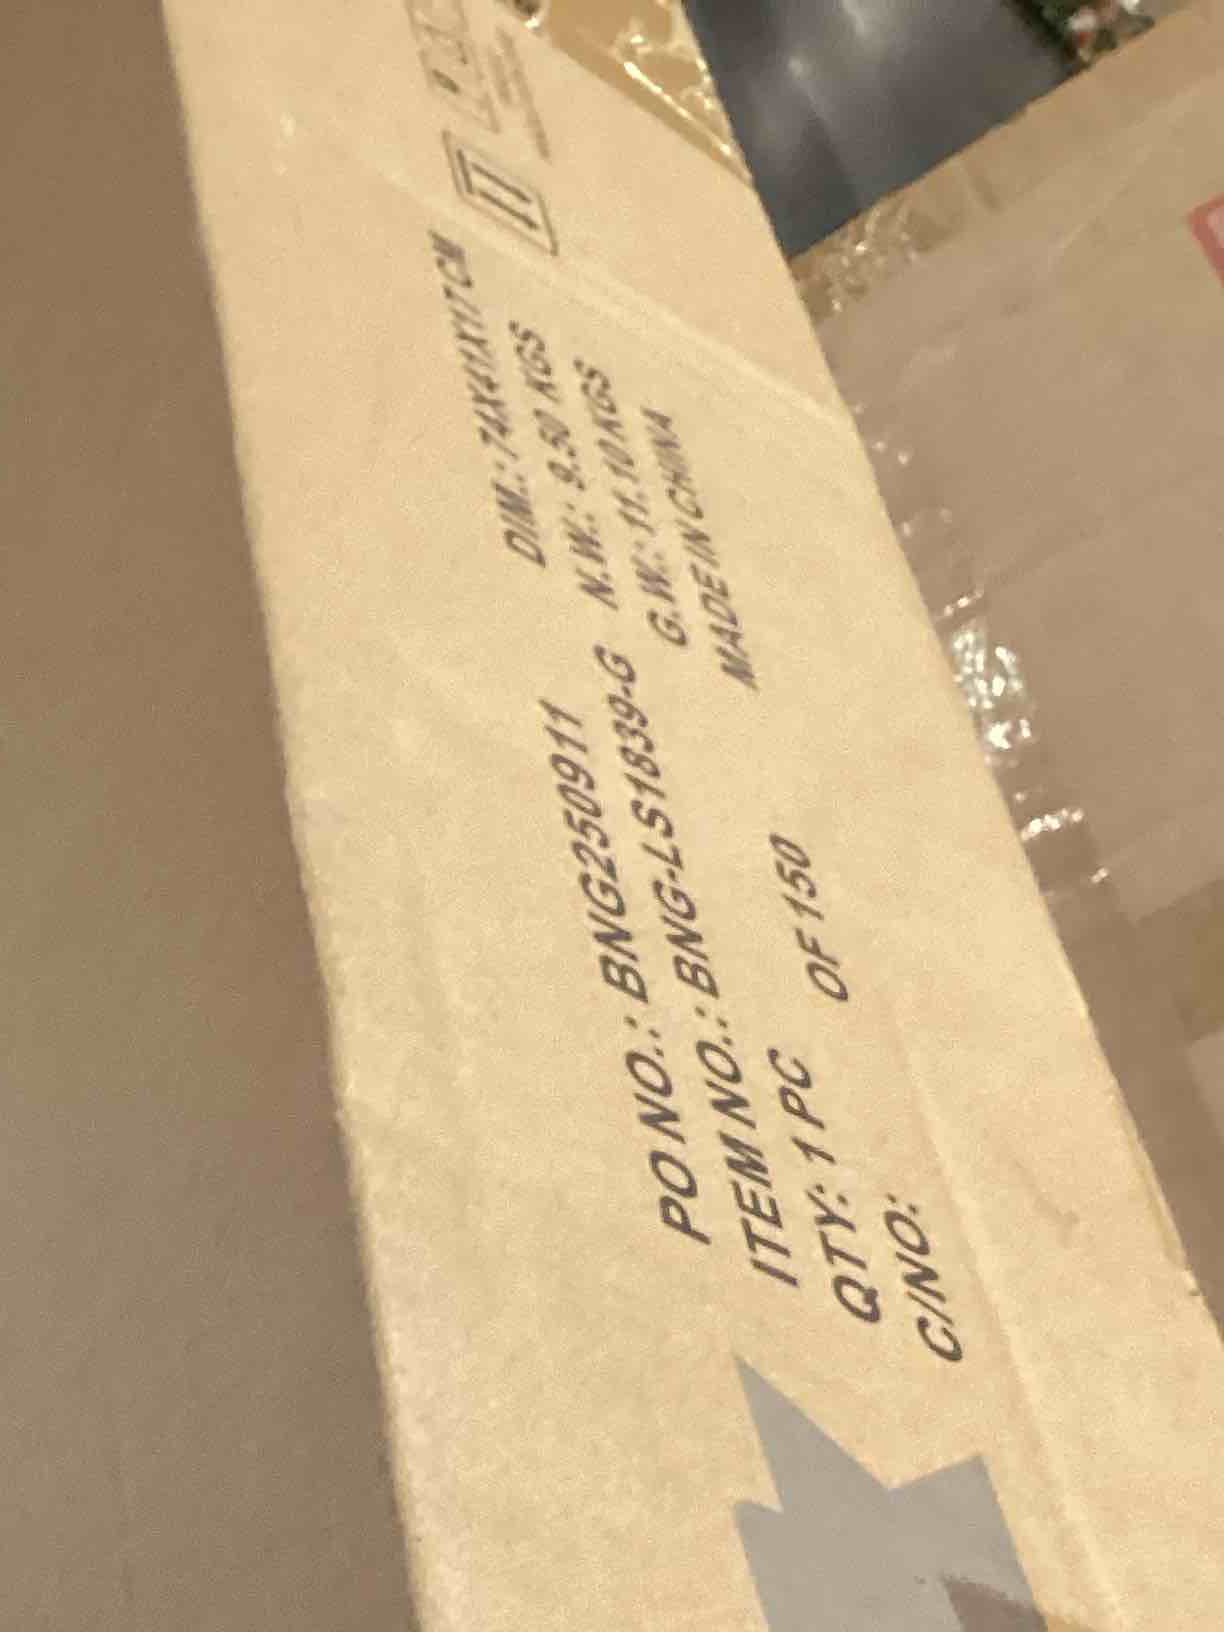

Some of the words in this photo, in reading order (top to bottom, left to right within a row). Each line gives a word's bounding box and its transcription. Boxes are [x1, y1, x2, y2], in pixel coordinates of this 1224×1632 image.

[509, 319, 561, 403] KGS
[640, 405, 703, 519] CHINA
[675, 517, 721, 568] IN
[690, 562, 759, 690] MADE
[538, 699, 648, 1003] BNG250911
[594, 645, 720, 1000] BNG-LS1839-G
[768, 833, 829, 922] 150
[788, 927, 849, 1003] OF
[624, 1015, 685, 1145] NO.:
[695, 1006, 757, 1130] NO.:
[767, 1048, 825, 1131] PC
[649, 1149, 712, 1245] PO
[790, 1137, 836, 1164] 1
[721, 1132, 800, 1289] ITEM
[804, 1184, 881, 1324] QTY:
[885, 1193, 963, 1363] C/NO:
